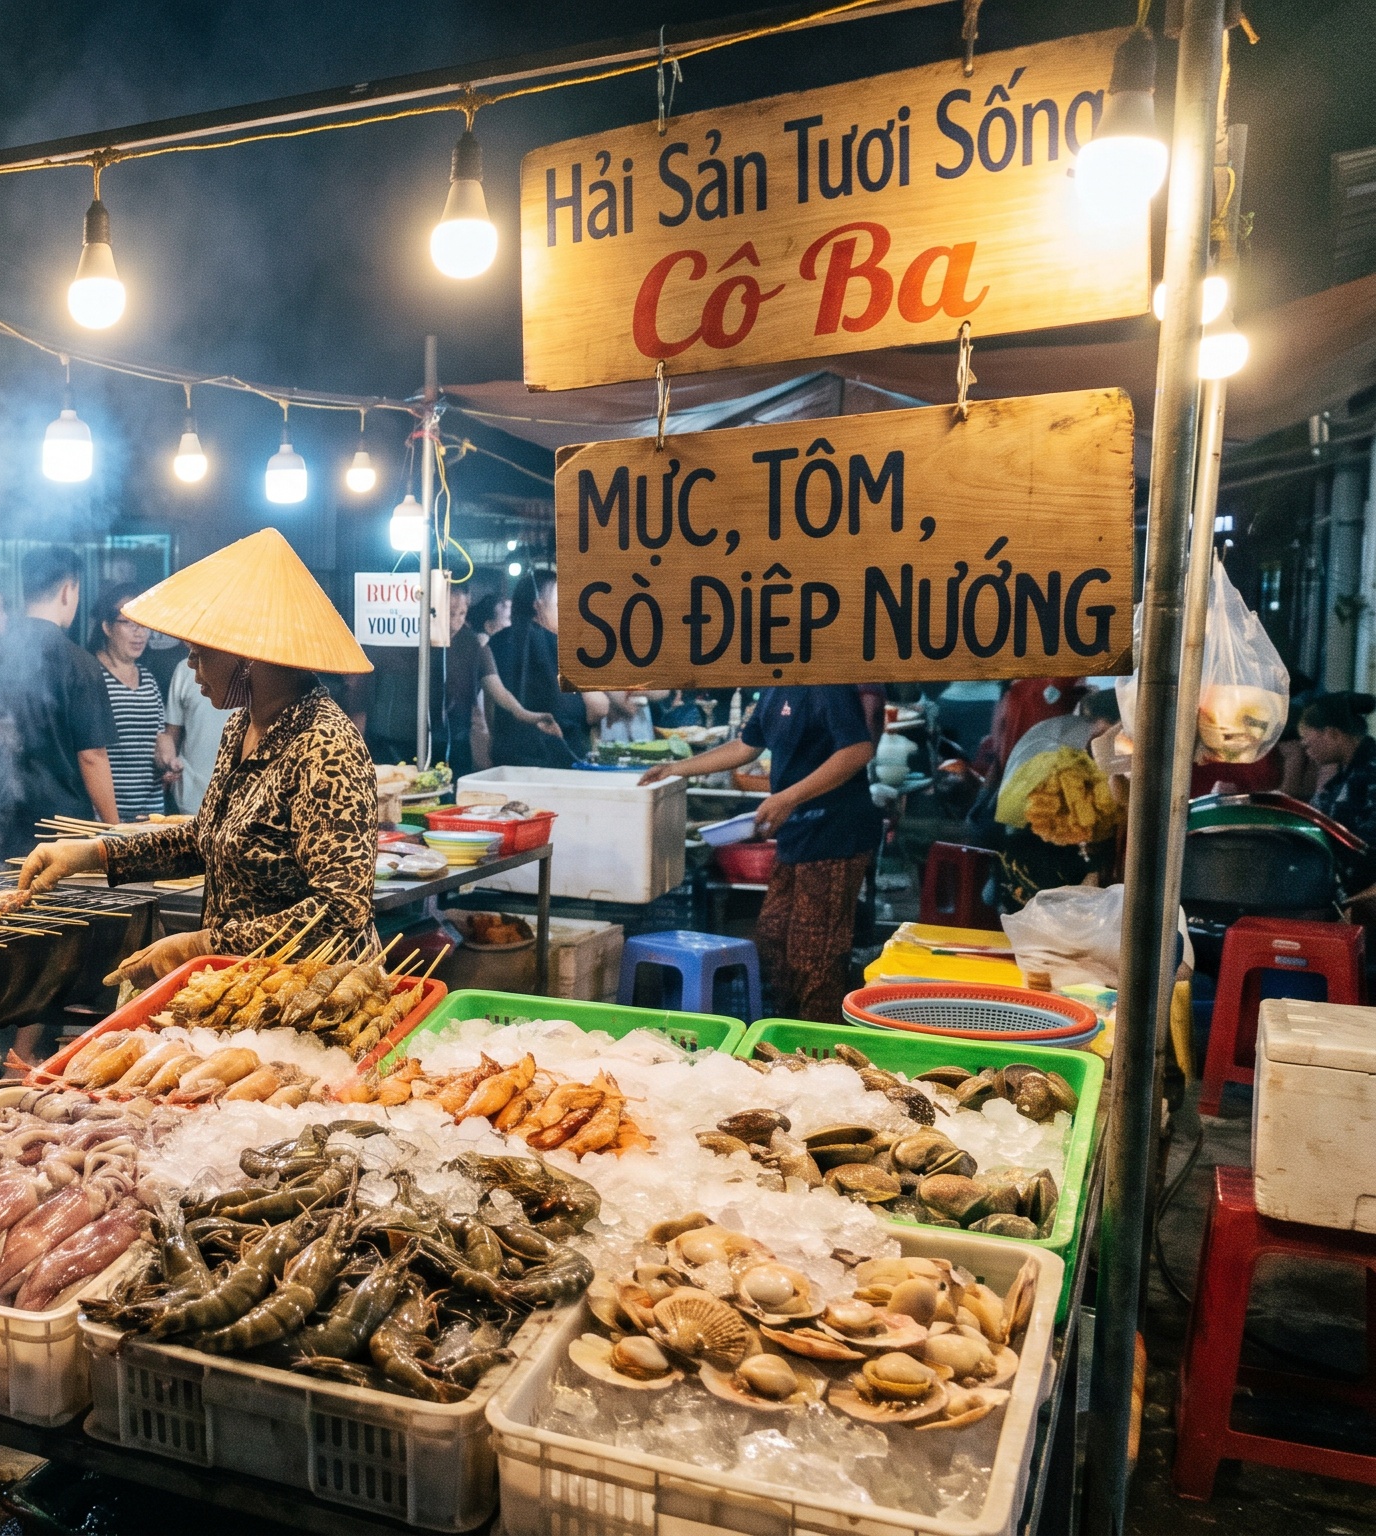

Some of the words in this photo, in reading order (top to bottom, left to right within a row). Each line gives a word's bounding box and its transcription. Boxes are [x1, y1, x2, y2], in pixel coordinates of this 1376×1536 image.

[546, 150, 634, 247] Hải
[657, 128, 768, 229] Sản
[784, 106, 911, 205] Tươi
[935, 66, 1105, 179] Sống
[632, 241, 786, 359] Cô
[799, 221, 989, 337] Ba
[577, 458, 740, 567] MỰC,
[368, 617, 396, 635] YOU
[576, 572, 663, 669] SÒ
[863, 536, 1117, 662] NƯỚNG
